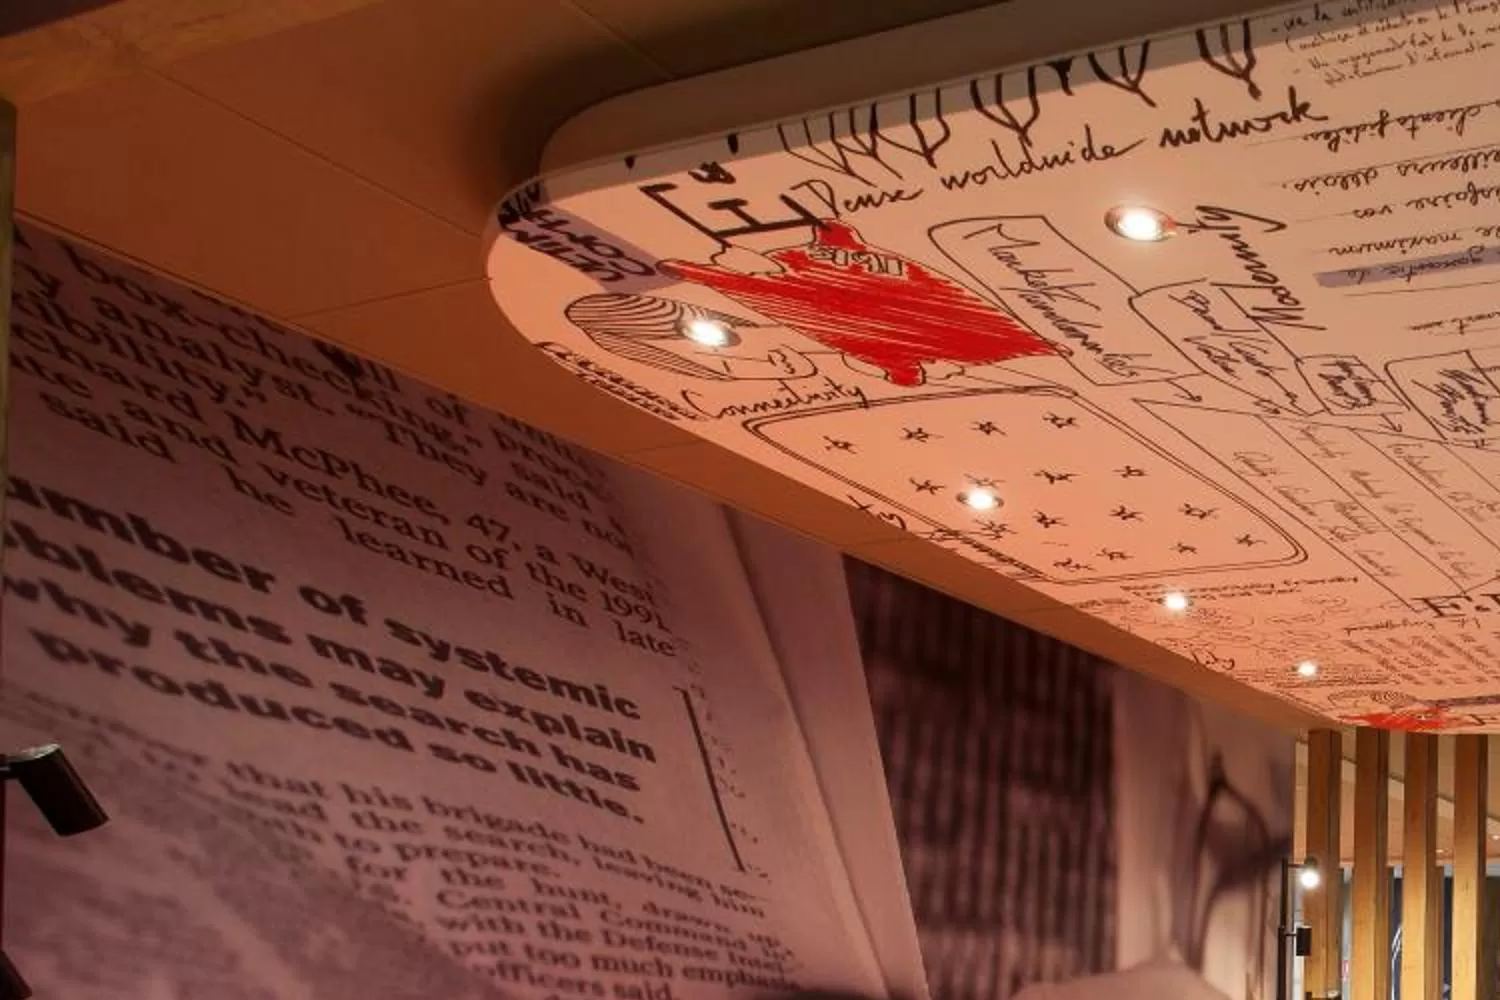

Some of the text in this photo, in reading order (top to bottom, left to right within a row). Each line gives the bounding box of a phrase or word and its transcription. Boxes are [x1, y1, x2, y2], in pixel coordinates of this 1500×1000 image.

[940, 123, 1145, 191] worldwide
[1351, 204, 1392, 220] vos
[39, 391, 679, 659] said he learned in late
[120, 399, 673, 635] and veteran of the 1991
[534, 543, 560, 567] a
[297, 585, 369, 627] of
[383, 617, 642, 721] systemic
[28, 627, 645, 825] produced so little.
[173, 628, 315, 690] the
[328, 681, 543, 760] search
[549, 743, 642, 793] has
[305, 633, 446, 701] may
[463, 690, 659, 764] explain
[340, 782, 414, 811] his
[420, 795, 572, 846] brigade
[350, 809, 427, 834] the
[436, 886, 583, 922] Central
[439, 866, 506, 890] the
[523, 944, 583, 970] too
[590, 953, 675, 981] much
[536, 918, 593, 945] the
[601, 929, 720, 962] Defense
